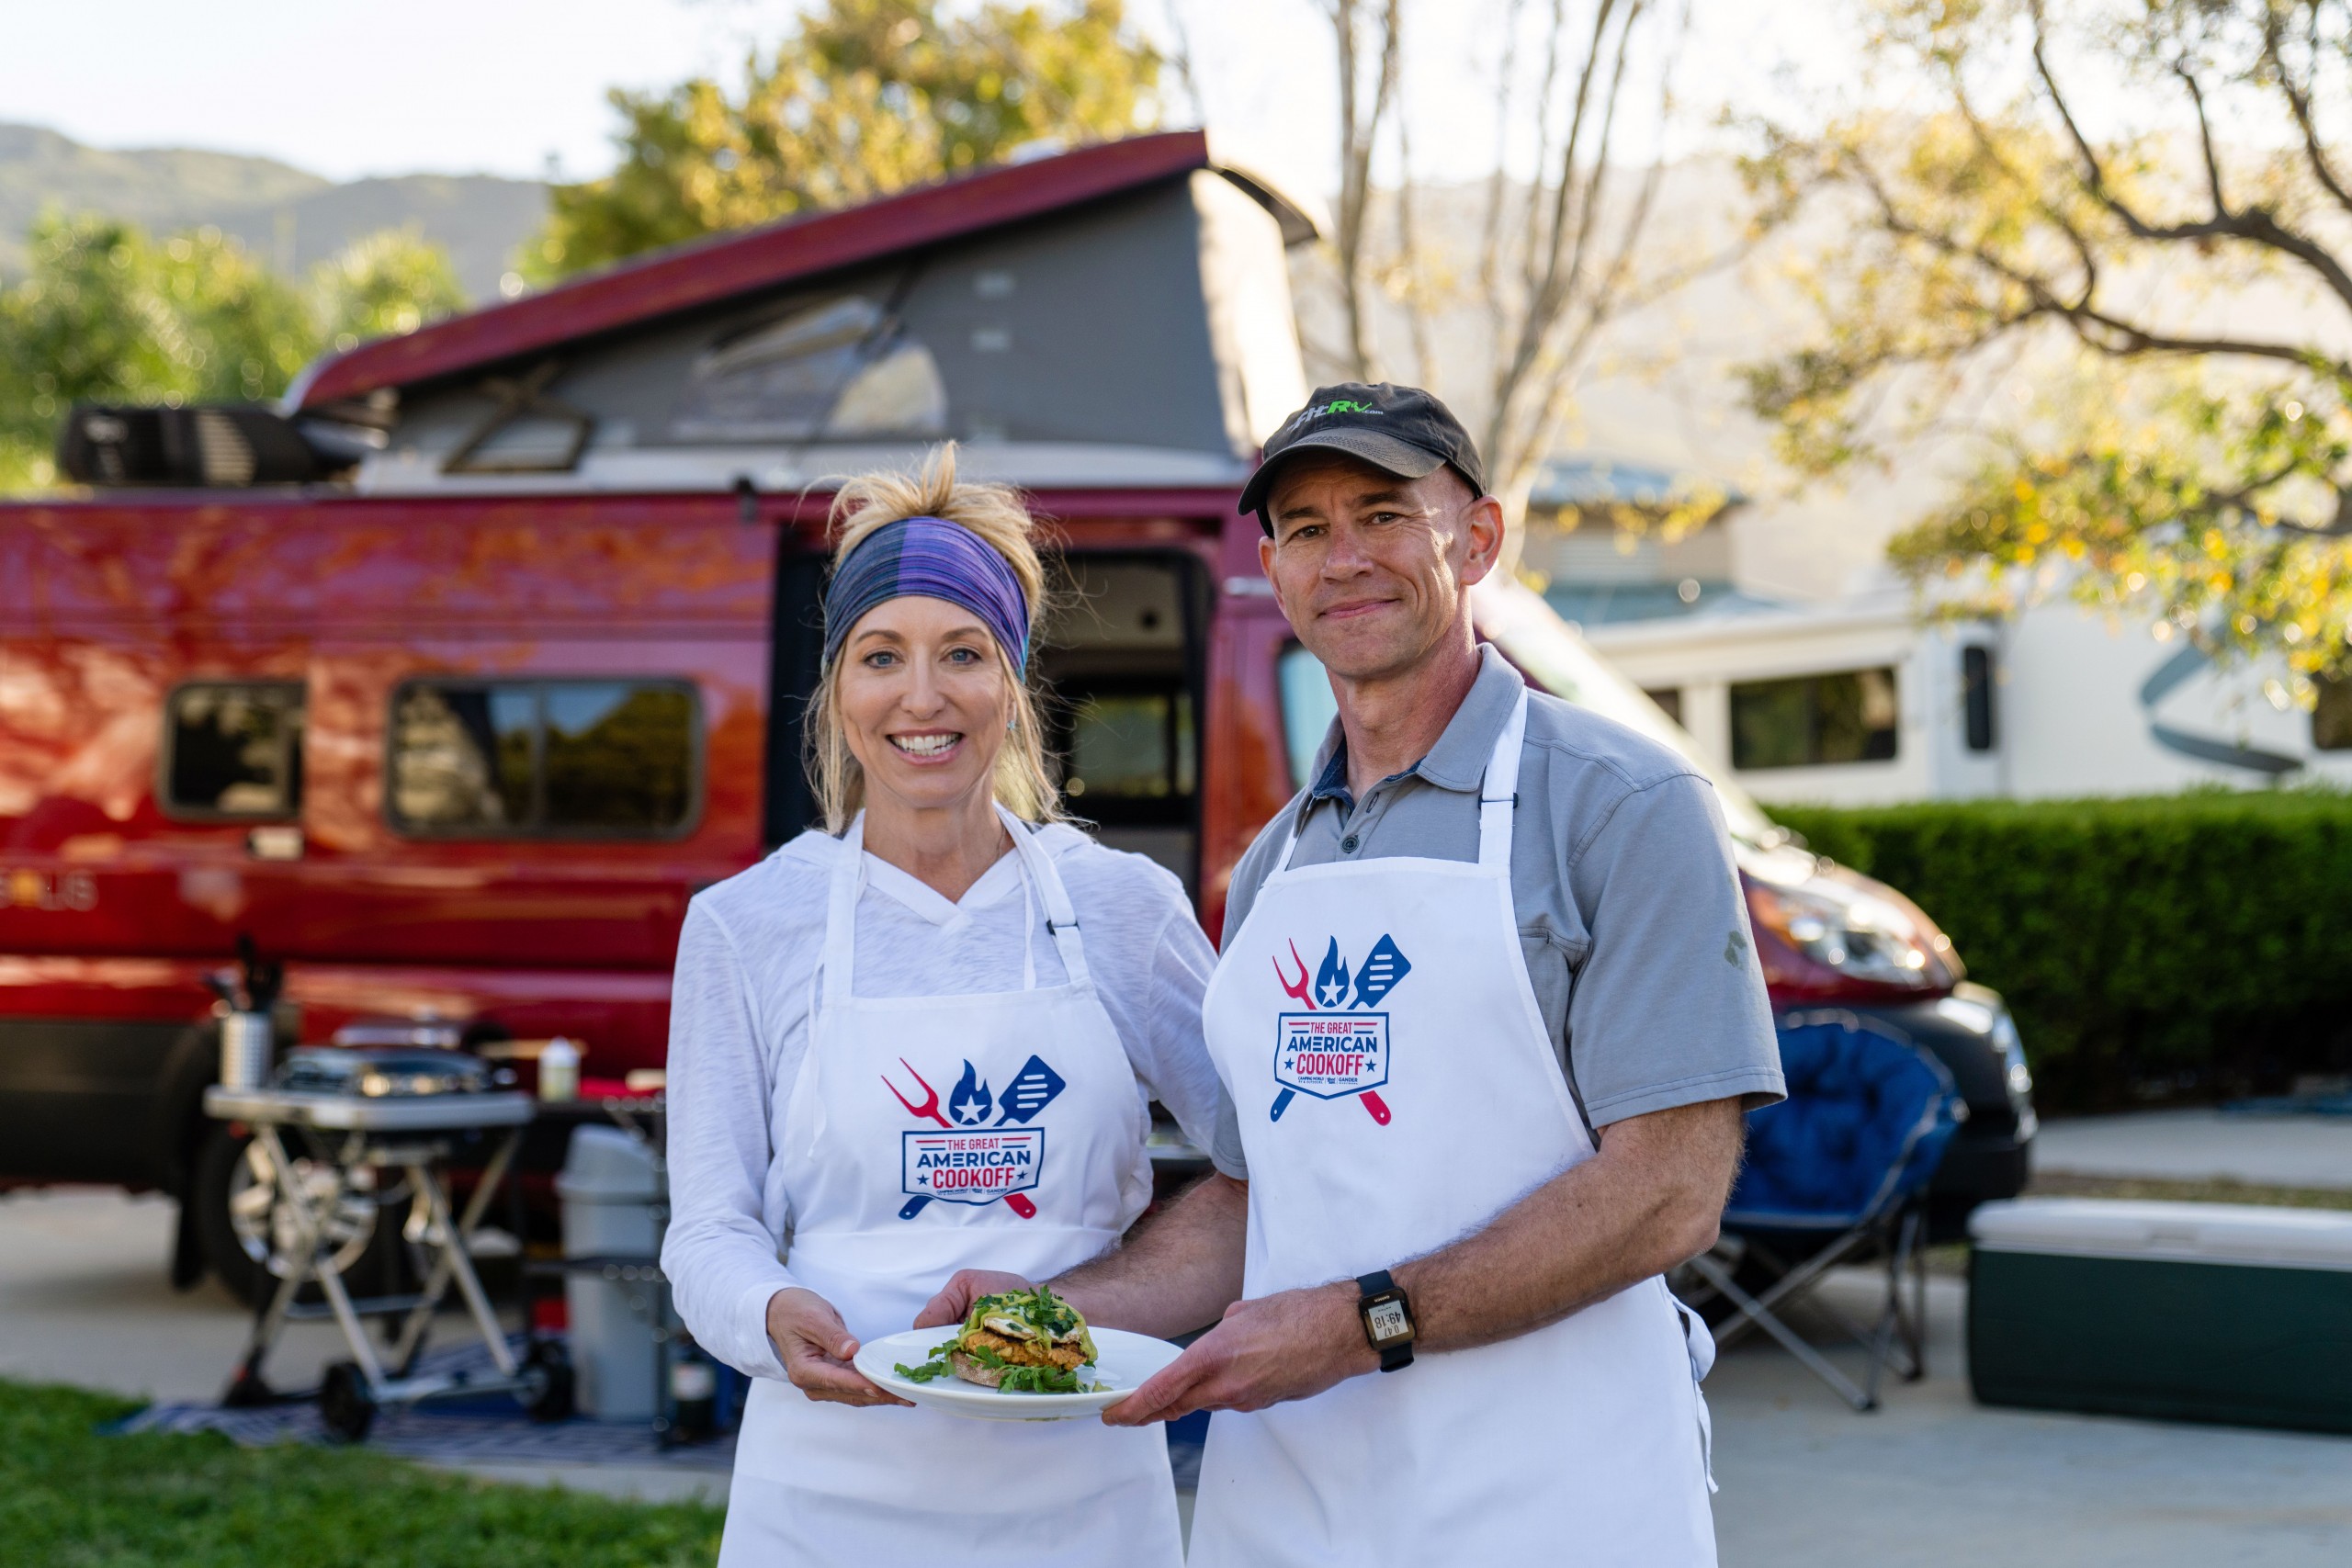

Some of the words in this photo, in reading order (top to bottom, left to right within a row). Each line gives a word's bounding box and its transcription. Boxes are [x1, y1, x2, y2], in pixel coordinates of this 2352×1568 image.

[1310, 1022, 1325, 1034] THE
[1328, 1022, 1352, 1034] GREAT
[1286, 1036, 1377, 1053] AMERICAN
[1296, 1054, 1364, 1076] COOKOFF
[947, 1139, 966, 1151] THE
[968, 1138, 1000, 1150] GREAT
[916, 1150, 1031, 1168] AMERICAN
[933, 1168, 1015, 1189] COOKOFF
[1374, 1312, 1401, 1329] 49:18
